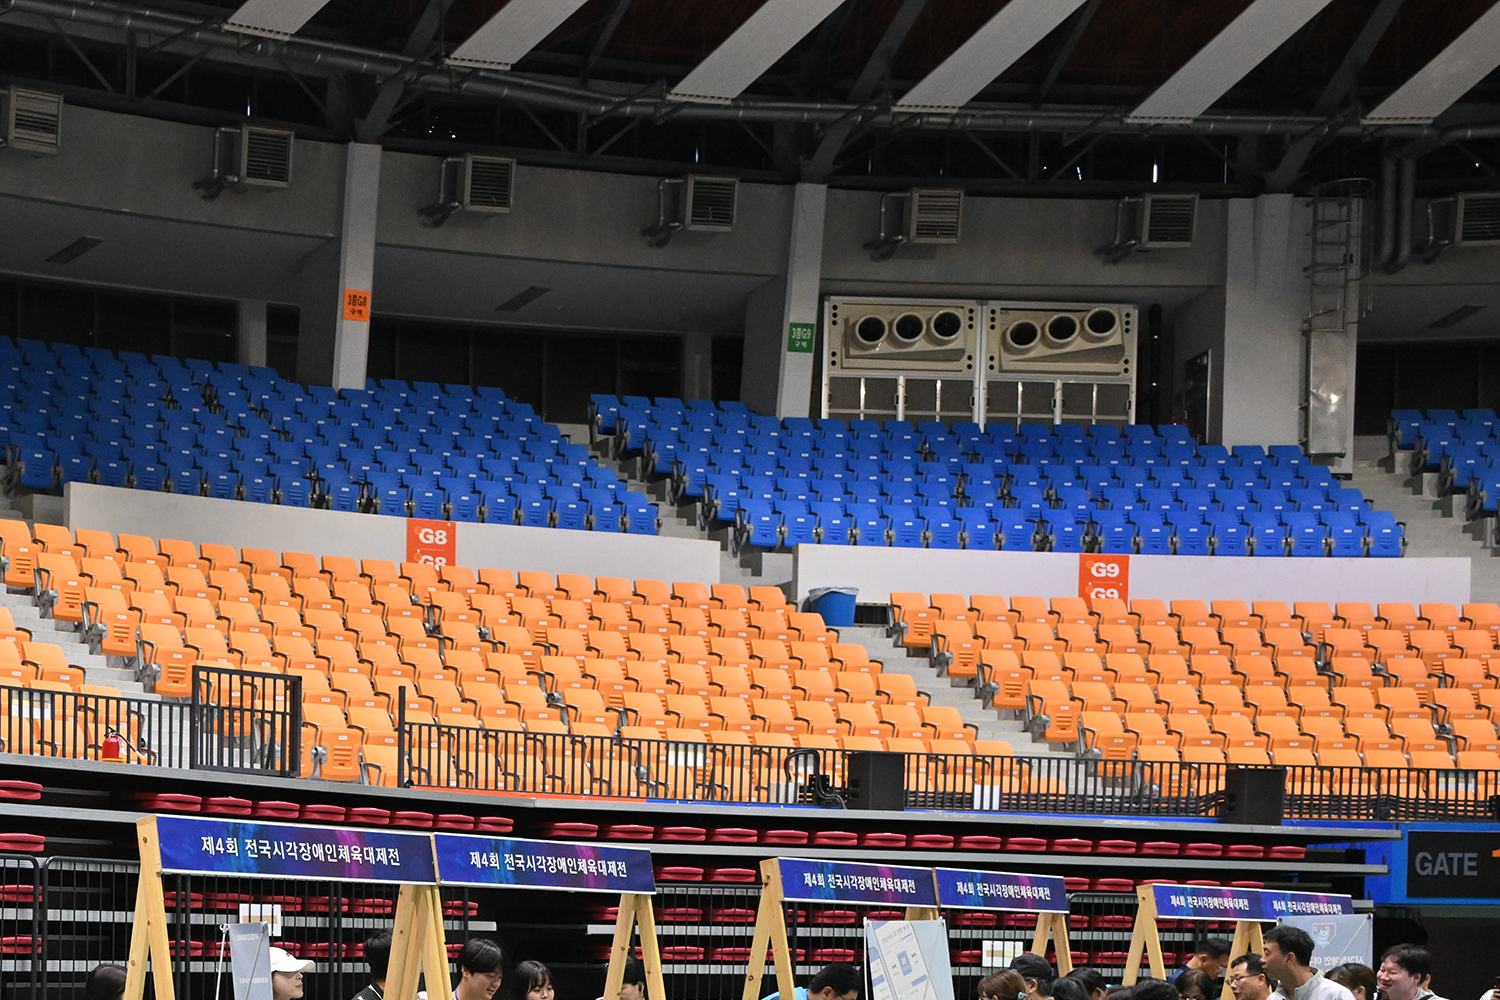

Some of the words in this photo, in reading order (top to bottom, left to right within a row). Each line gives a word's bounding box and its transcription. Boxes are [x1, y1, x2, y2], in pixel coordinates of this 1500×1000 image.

[419, 528, 447, 544] G8
[1091, 562, 1119, 577] G9
[201, 835, 240, 858] 제4회
[245, 838, 400, 867] 전국시각장애인체육대제전
[470, 851, 500, 870] 제4회
[504, 854, 627, 878] 전국시각장애인체육대제전
[1415, 851, 1478, 877] GATE
[804, 872, 825, 888] 제4회
[828, 873, 916, 894] 전국시각장애인체육대제전
[957, 881, 975, 896] 제4회
